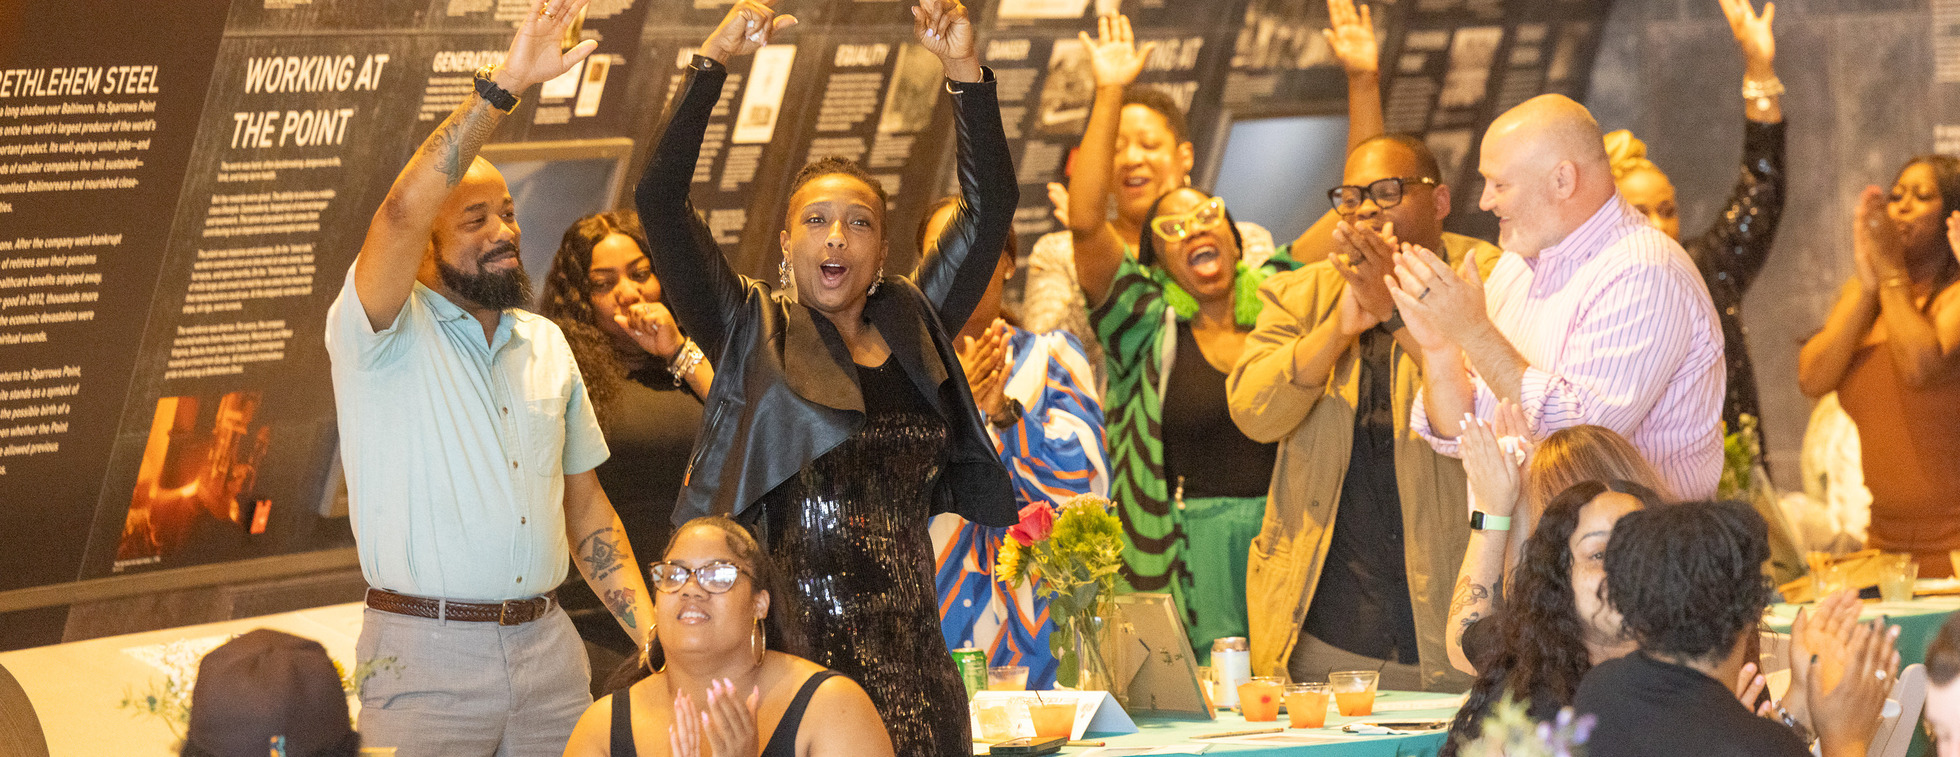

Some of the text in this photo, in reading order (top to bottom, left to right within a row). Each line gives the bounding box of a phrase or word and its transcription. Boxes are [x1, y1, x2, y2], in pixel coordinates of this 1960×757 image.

[103, 65, 159, 94] STEEL
[245, 54, 390, 94] WORKING AT
[4, 106, 20, 118] long
[20, 105, 45, 116] shadow
[46, 105, 61, 115] over
[106, 101, 138, 114] Sparrows
[138, 100, 156, 112] Point
[4, 127, 20, 135] once
[21, 124, 32, 135] the
[58, 123, 82, 135] largest
[81, 122, 113, 134] producer
[112, 121, 121, 131] of
[120, 121, 132, 131] the
[231, 108, 355, 149] THE POINT
[9, 163, 18, 174] of
[17, 162, 44, 173] smaller
[44, 161, 79, 173] companies
[79, 160, 91, 170] the
[71, 179, 85, 190] and
[14, 238, 32, 249] After
[32, 238, 44, 248] the
[44, 238, 75, 249] company
